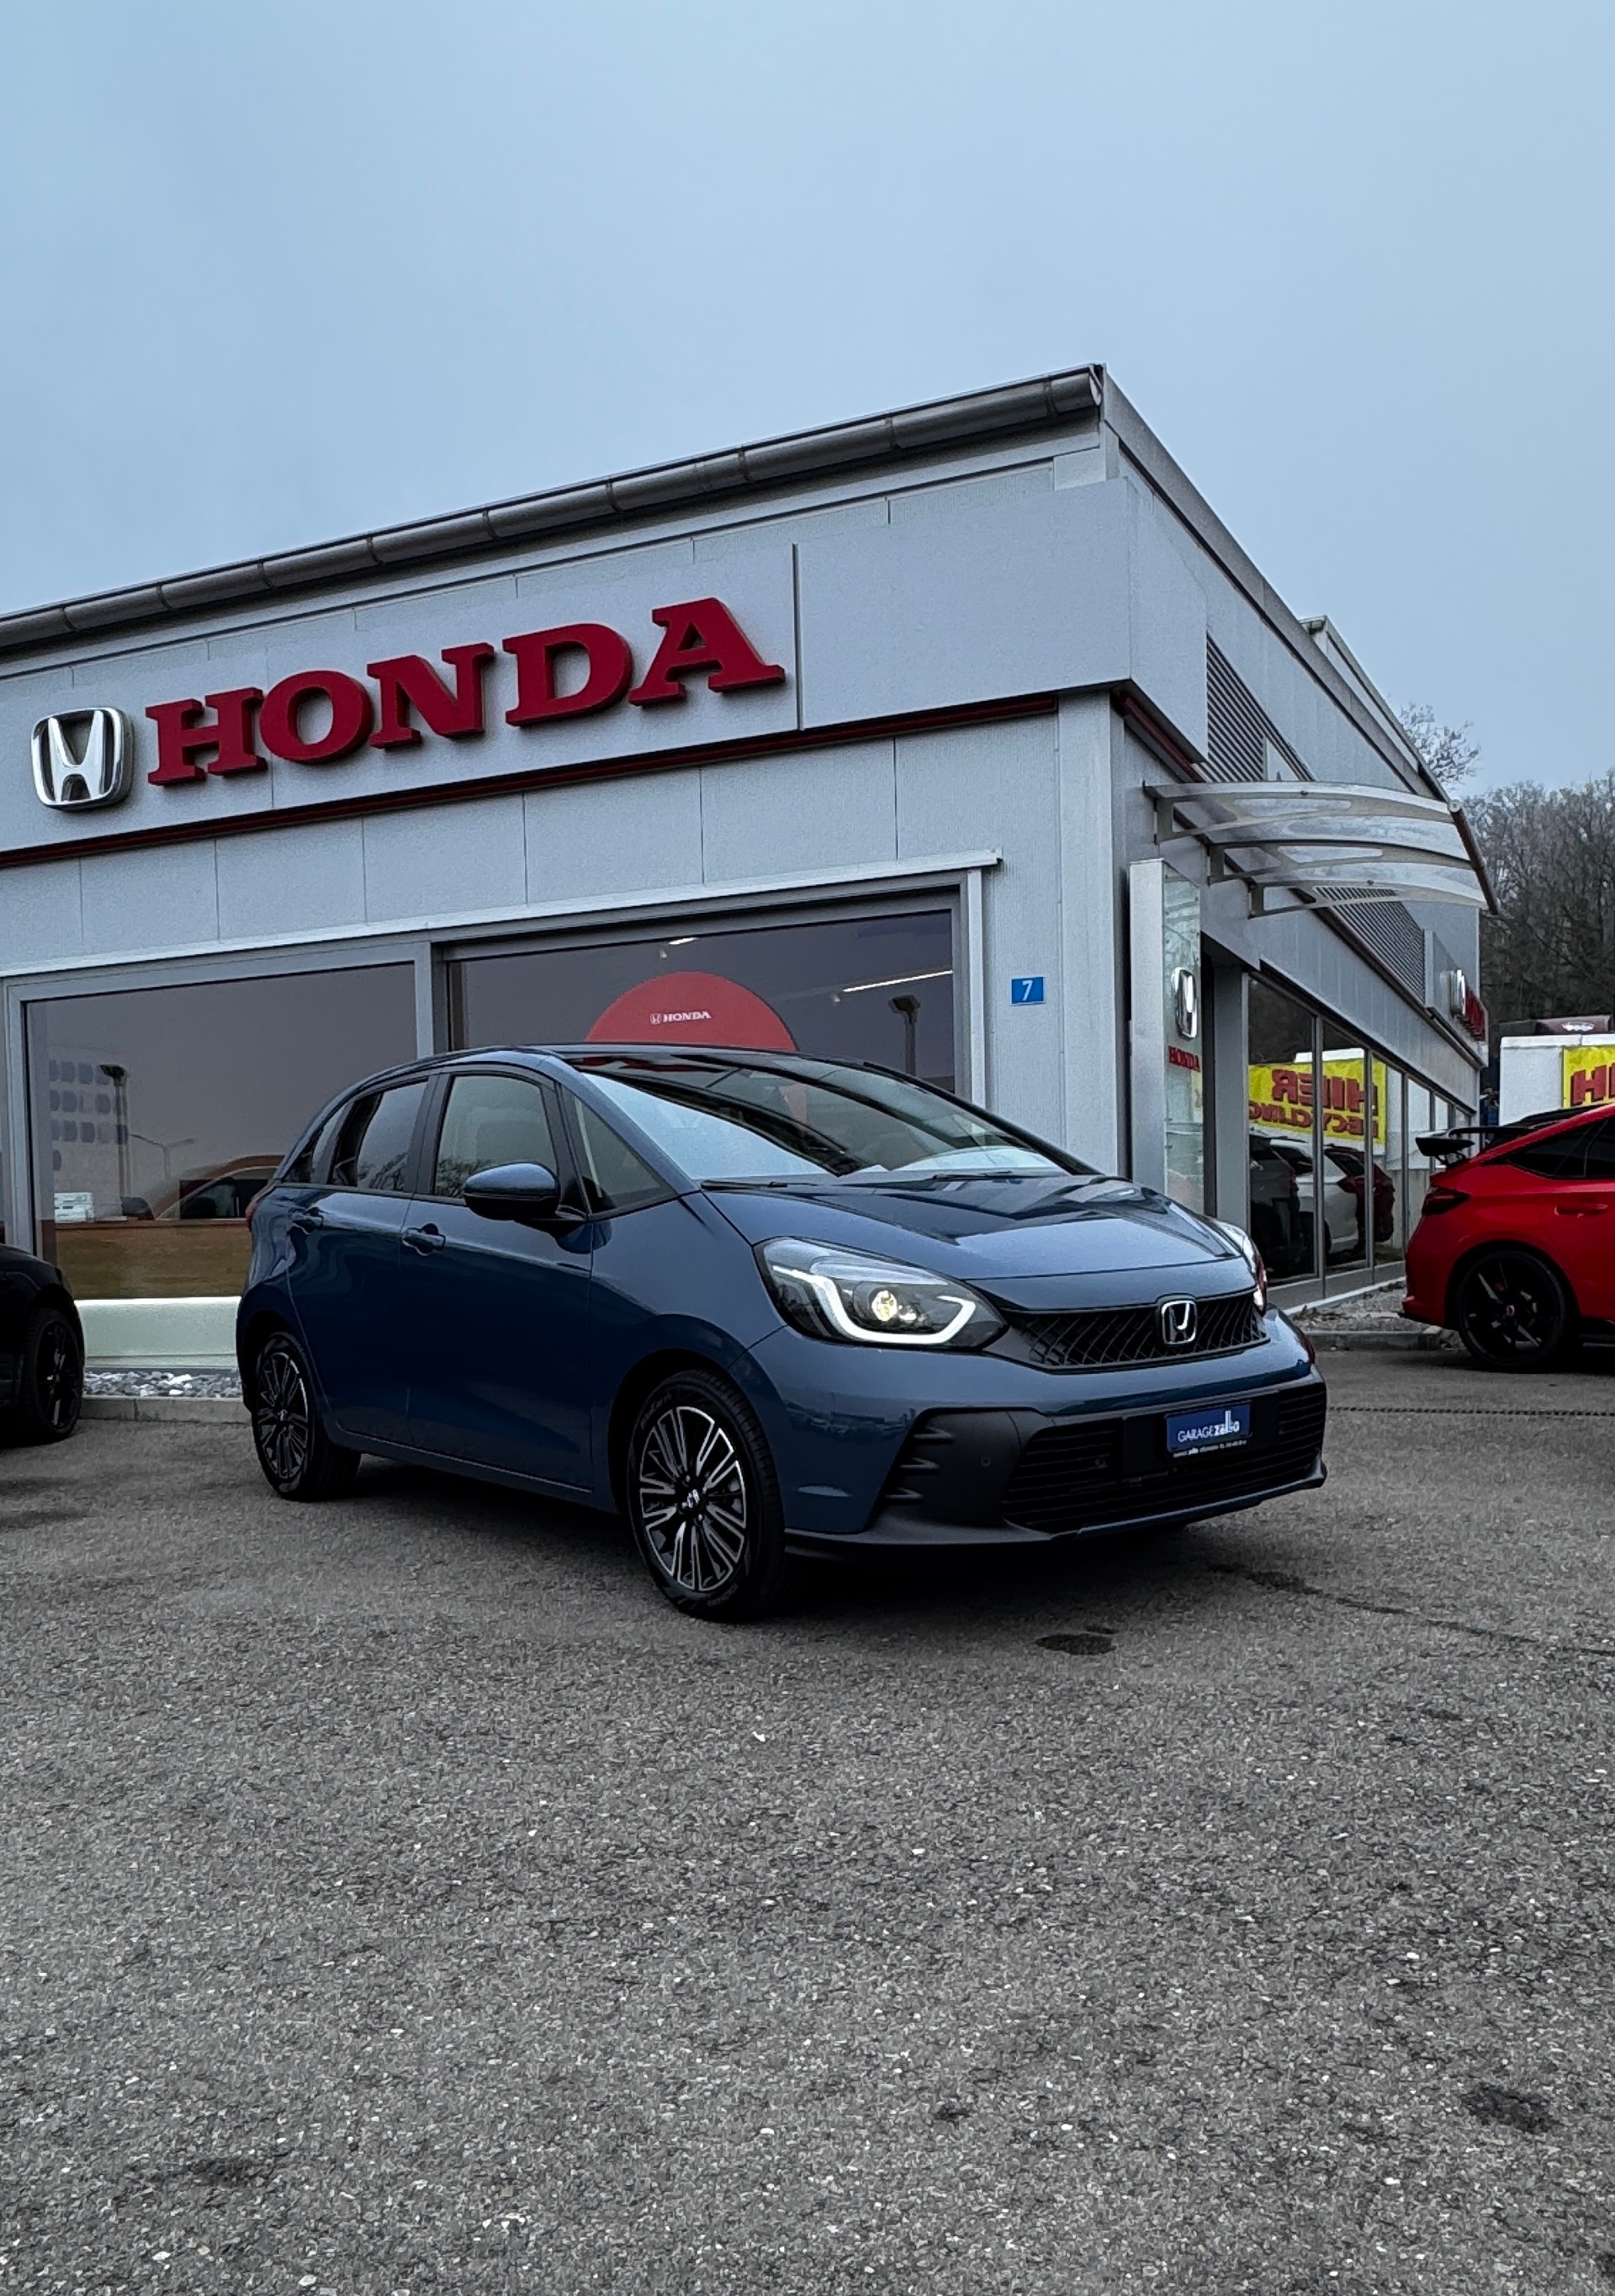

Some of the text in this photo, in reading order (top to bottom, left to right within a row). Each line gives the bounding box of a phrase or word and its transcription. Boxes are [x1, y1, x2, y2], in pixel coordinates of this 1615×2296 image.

[146, 597, 786, 786] HONDA
[1022, 979, 1034, 1001] 7
[663, 1010, 712, 1023] HONDA
